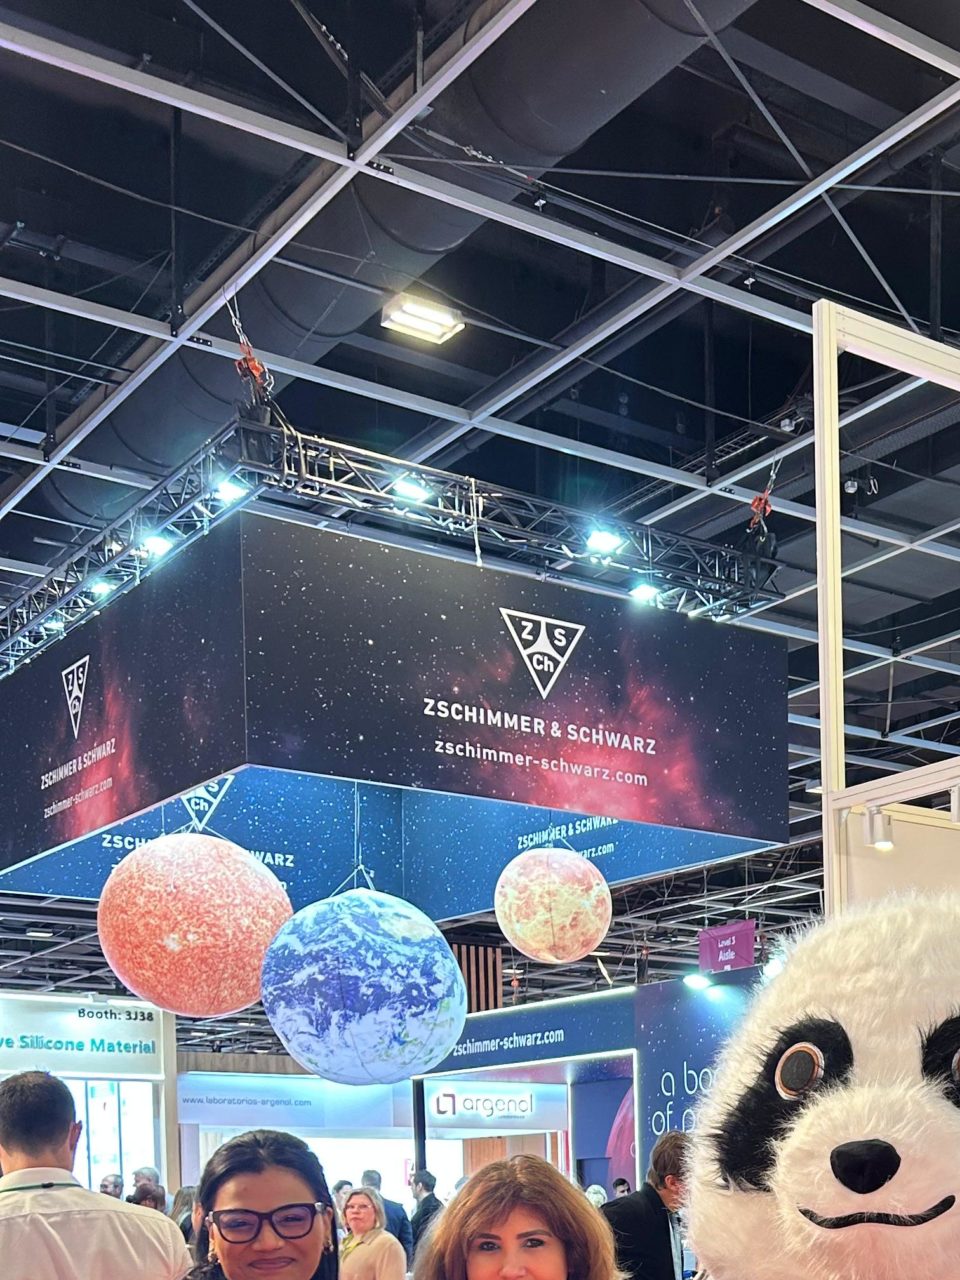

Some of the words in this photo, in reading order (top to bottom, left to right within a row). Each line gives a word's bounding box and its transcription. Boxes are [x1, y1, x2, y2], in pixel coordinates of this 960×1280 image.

[423, 697, 546, 737] ZSCHIMMER
[551, 721, 562, 738] &
[567, 723, 657, 755] SCHWARZ
[40, 758, 77, 790] ZSCHIMMER
[83, 737, 116, 769] SCHWARZ
[434, 740, 649, 787] zschimmer-schwarz.com
[78, 1008, 122, 1021] Booth:
[125, 1010, 154, 1021] 3J38
[19, 1035, 85, 1051] Silicone
[90, 1038, 156, 1054] Material
[452, 1028, 565, 1057] zschimmer-schwarz.com
[462, 1093, 533, 1118] argenol
